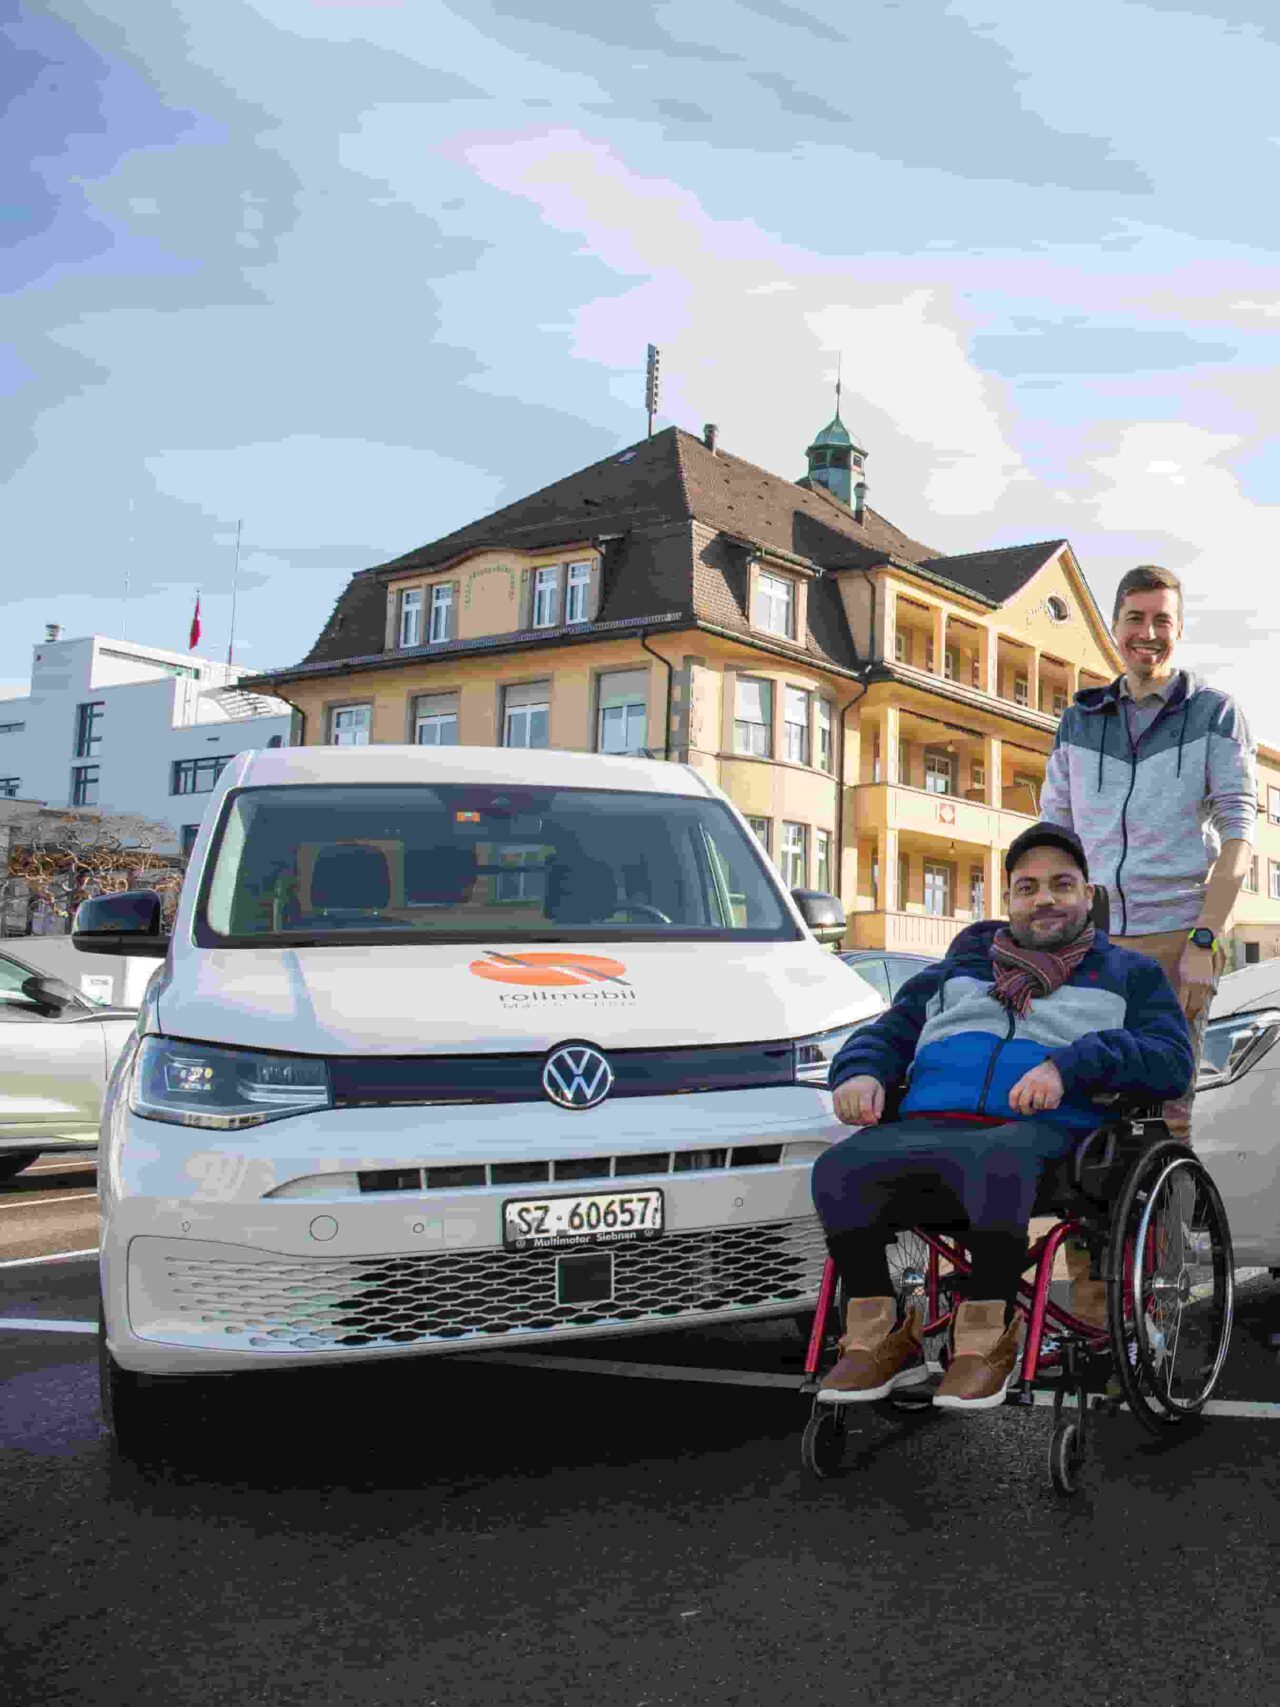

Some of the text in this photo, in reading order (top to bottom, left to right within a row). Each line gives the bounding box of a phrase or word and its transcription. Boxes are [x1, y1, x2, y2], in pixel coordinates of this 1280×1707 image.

[499, 990, 636, 1002] rollmobil
[517, 1198, 651, 1235] SZ 60657
